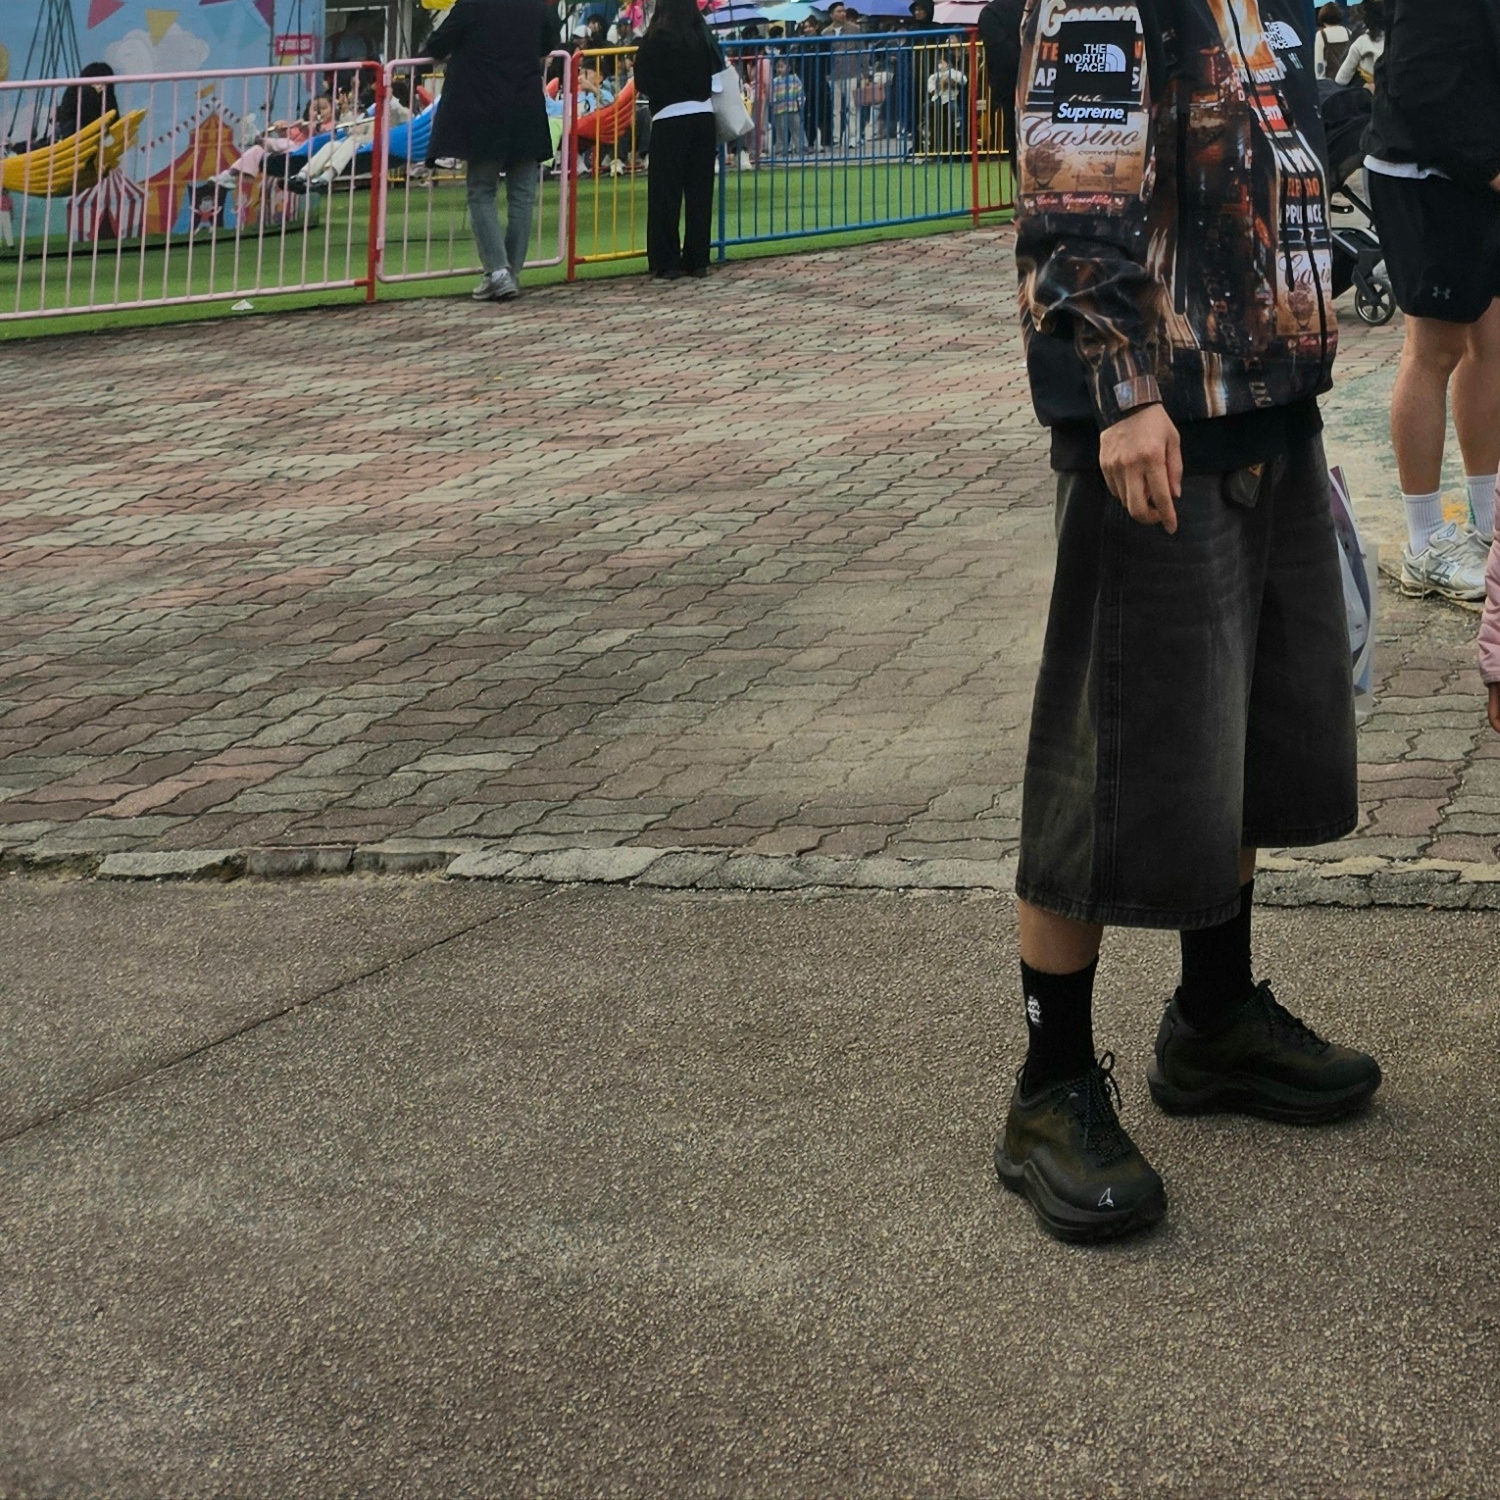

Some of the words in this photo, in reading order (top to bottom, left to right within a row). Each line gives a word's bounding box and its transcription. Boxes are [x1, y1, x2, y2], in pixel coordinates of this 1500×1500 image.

[1083, 43, 1106, 54] THE
[1065, 53, 1106, 64] NORTH
[1075, 62, 1106, 73] FACE
[1057, 102, 1125, 122] Supreme
[1021, 115, 1141, 148] Casino
